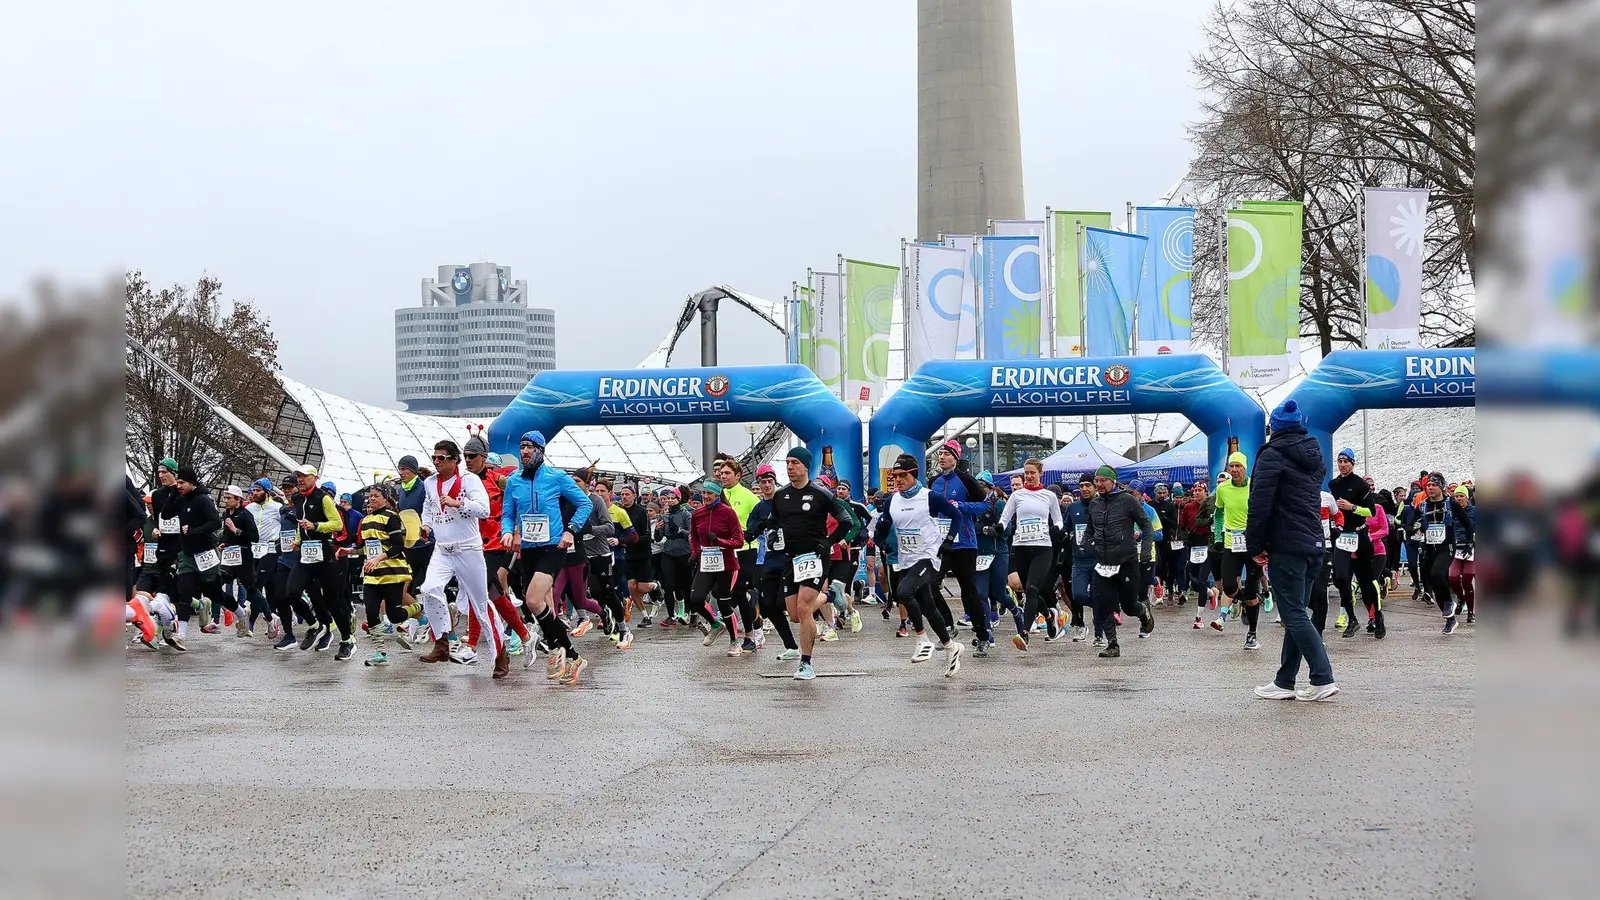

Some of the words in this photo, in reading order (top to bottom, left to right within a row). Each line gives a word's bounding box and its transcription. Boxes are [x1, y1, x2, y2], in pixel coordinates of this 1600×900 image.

[990, 365, 1103, 389] ERDINGER
[598, 377, 704, 400] ERDINGER
[991, 390, 1130, 404] ALKOHOLFREI
[599, 400, 730, 414] ALKOHOLFREI
[525, 522, 543, 533] 277
[1021, 524, 1041, 534] 1151
[1427, 530, 1443, 538] 1417
[223, 552, 240, 560] 2076
[304, 547, 318, 555] 329
[199, 552, 214, 563] 455
[704, 556, 719, 565] 330
[798, 561, 816, 573] 673
